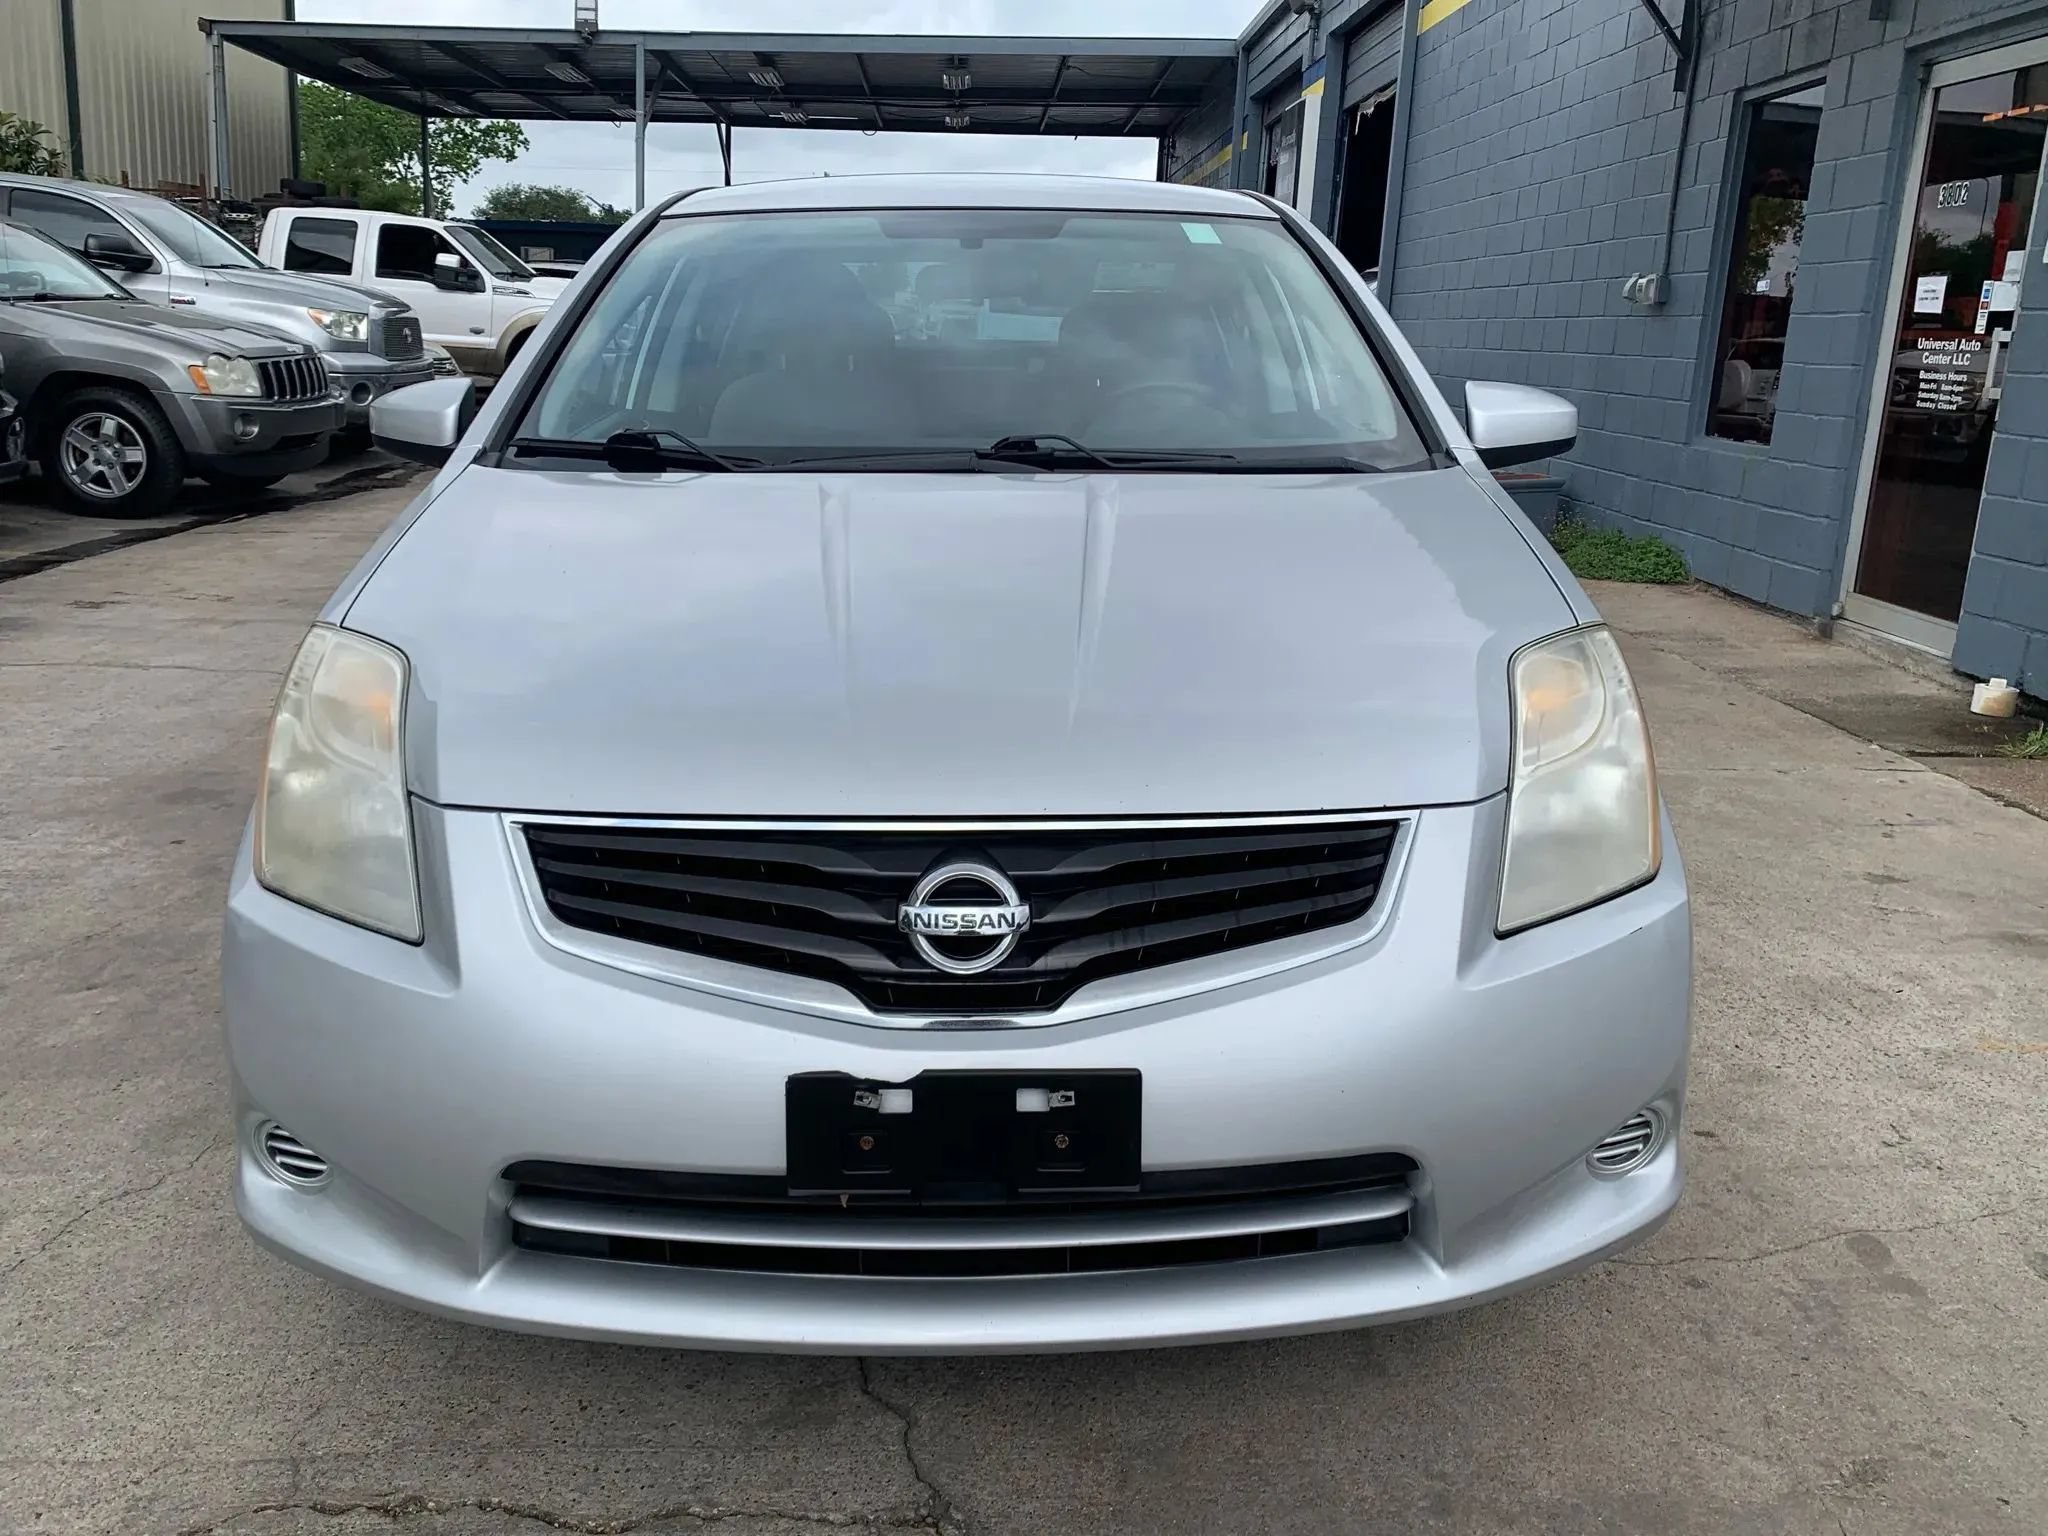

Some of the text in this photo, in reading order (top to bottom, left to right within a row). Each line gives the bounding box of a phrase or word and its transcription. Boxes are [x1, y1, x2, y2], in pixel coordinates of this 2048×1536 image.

[1937, 181, 1970, 208] 3802
[1917, 337, 1981, 351] Universal Auto
[1922, 351, 1971, 365] Center LLC
[1919, 370, 1968, 382] Business Hours
[1917, 391, 1939, 400] Saturday
[1915, 400, 1957, 410] Sunday Closed
[913, 912, 1016, 930] NISSAN
